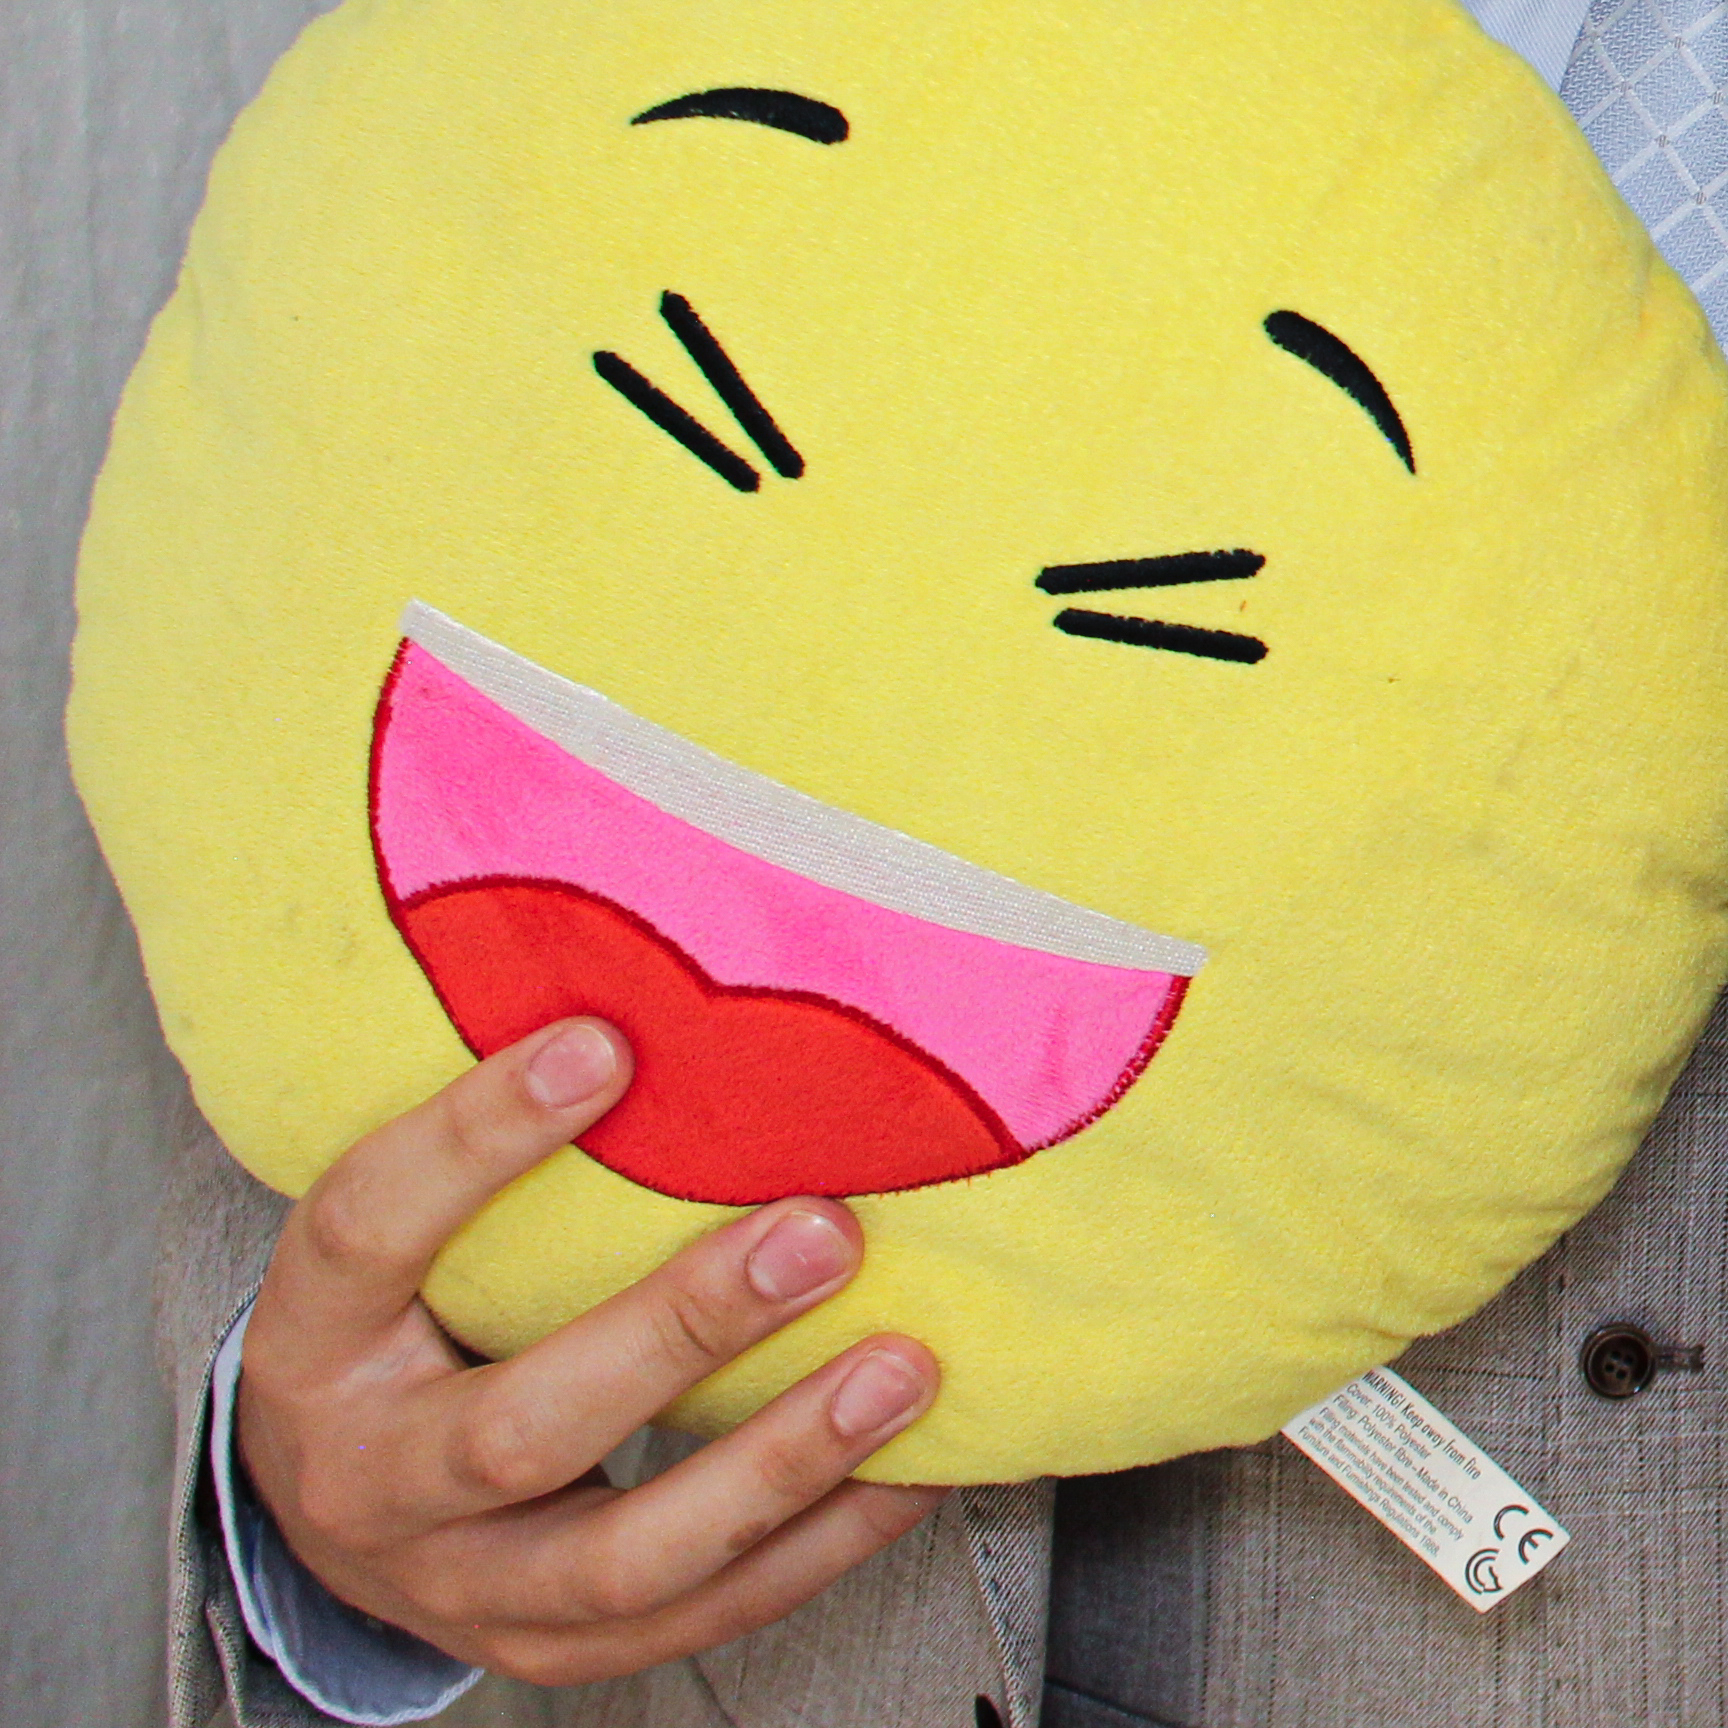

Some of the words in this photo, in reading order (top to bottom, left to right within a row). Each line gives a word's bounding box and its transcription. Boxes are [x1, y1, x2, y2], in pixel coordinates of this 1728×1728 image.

[1358, 1415, 1396, 1451] Polyester
[1394, 1447, 1413, 1468] fibre
[1416, 1467, 1439, 1491] Made
[1437, 1488, 1449, 1501] in
[1447, 1496, 1473, 1524] China
[1372, 1404, 1396, 1429] 100%
[1394, 1423, 1431, 1459] Polyester
[1401, 1403, 1424, 1429] Keep
[1421, 1424, 1445, 1448] away
[1443, 1439, 1466, 1465] from
[1463, 1457, 1481, 1480] fire
[1369, 1451, 1388, 1471] have
[1385, 1466, 1404, 1485] been
[1402, 1481, 1426, 1504] tested
[1423, 1501, 1440, 1517] and
[1437, 1515, 1463, 1541] comply
[1415, 1513, 1427, 1523] of
[1423, 1519, 1437, 1535] the
